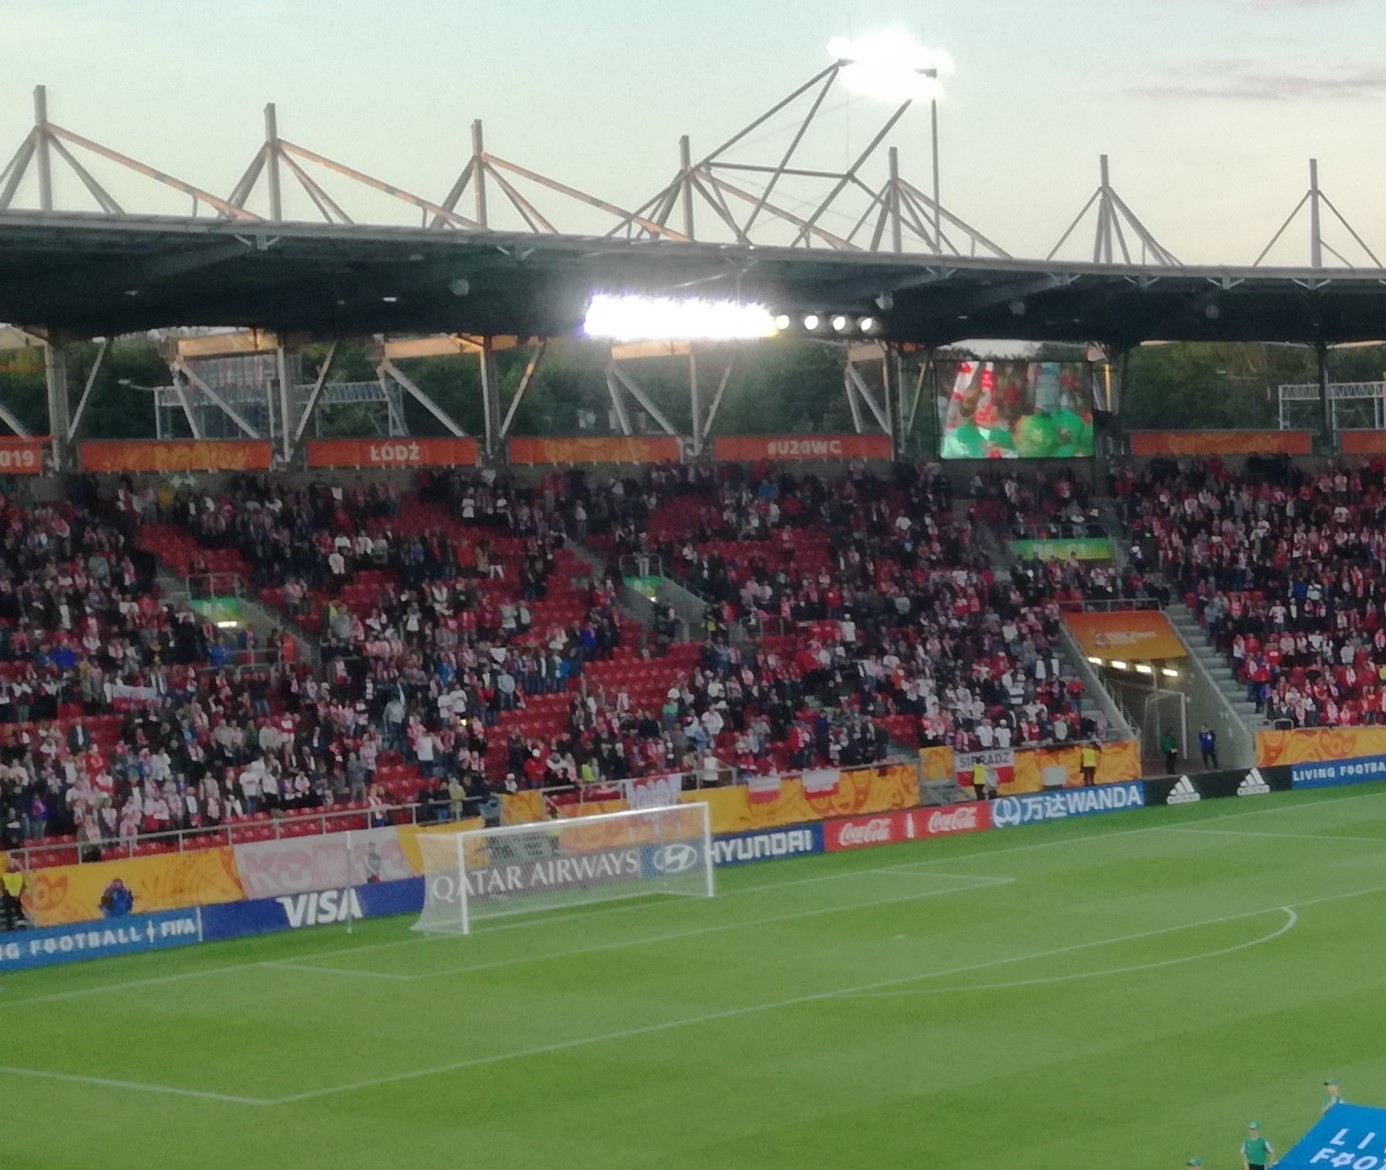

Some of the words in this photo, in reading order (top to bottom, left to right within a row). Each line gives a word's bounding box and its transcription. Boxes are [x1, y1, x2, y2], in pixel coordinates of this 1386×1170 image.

[370, 443, 420, 462] ŁÓDŹ
[1292, 767, 1335, 782] LIVING
[1066, 784, 1144, 814] WANDA
[838, 817, 892, 847] Coca-Cola
[927, 805, 978, 834] Coca-Cola
[704, 829, 813, 864] HYUNDAI
[433, 865, 523, 903] QATAR
[530, 850, 640, 887] AIRWAYS
[277, 887, 363, 928] VISA
[30, 926, 141, 956] FOOTBALL
[161, 918, 196, 937] FIFA
